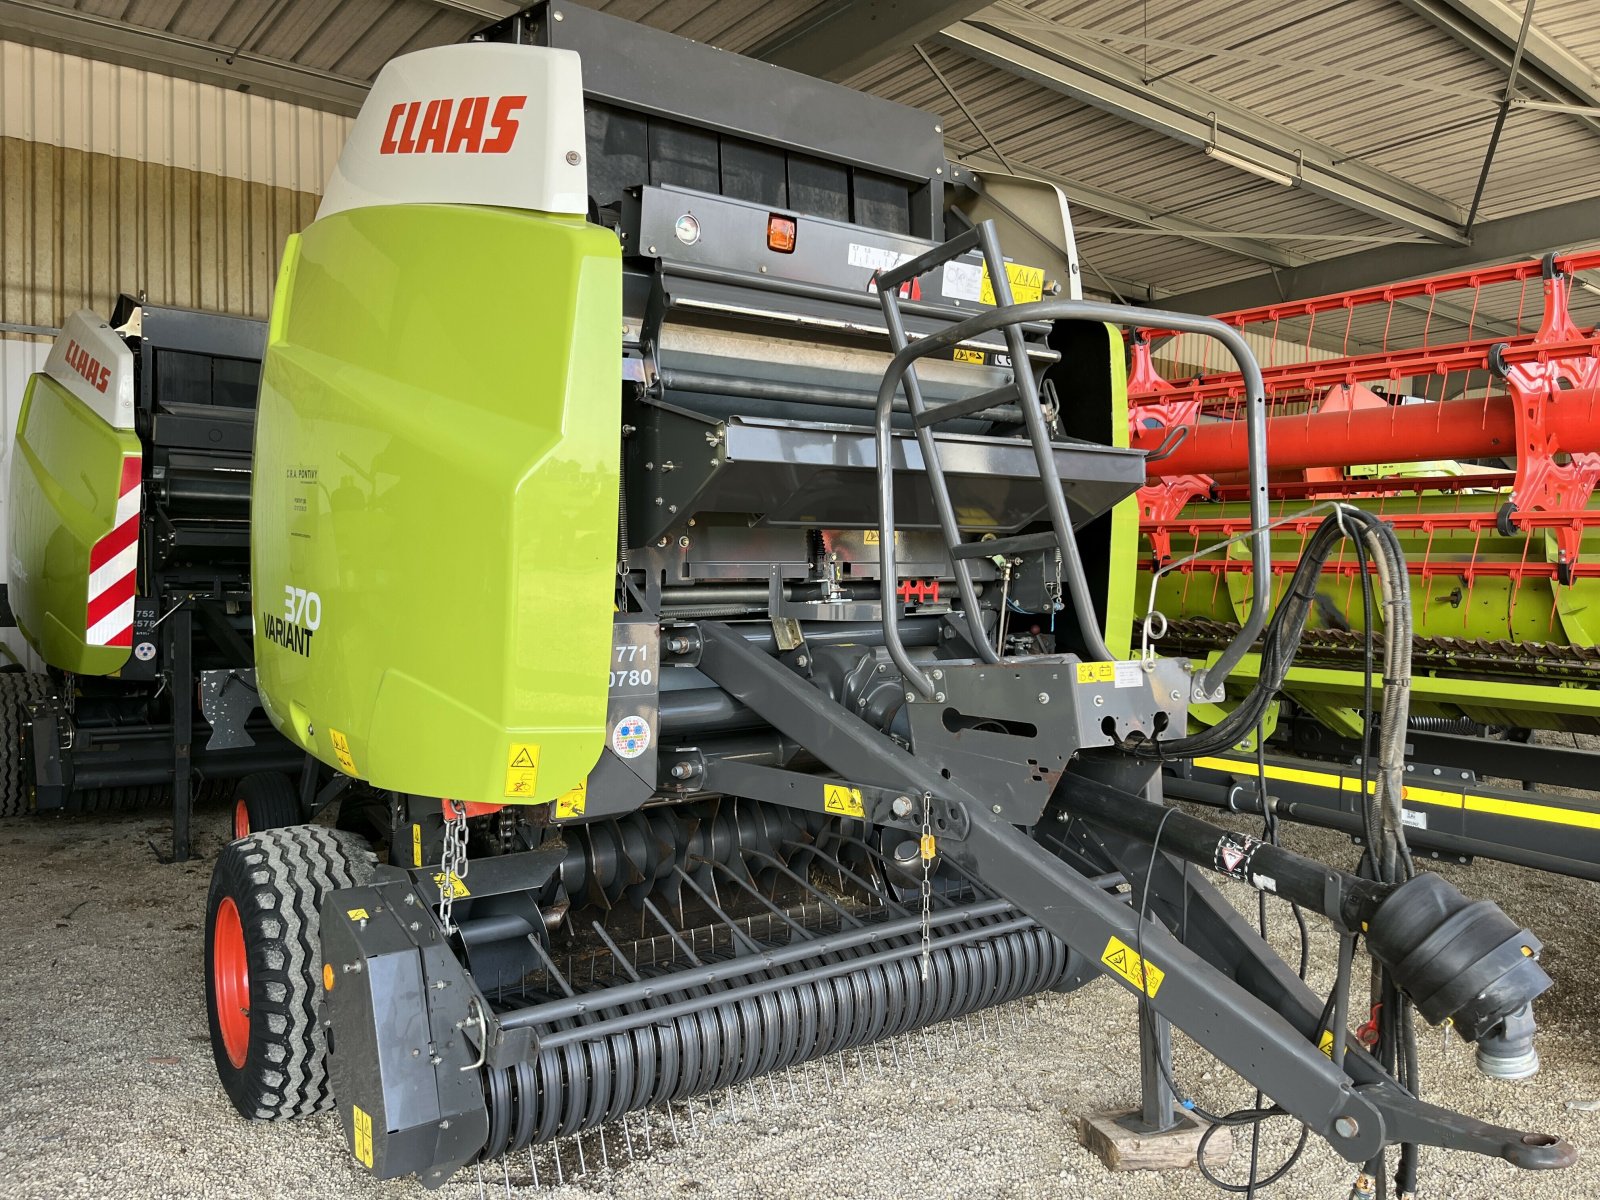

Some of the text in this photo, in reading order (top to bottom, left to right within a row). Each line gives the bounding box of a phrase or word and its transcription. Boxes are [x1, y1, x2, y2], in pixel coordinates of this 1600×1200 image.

[380, 96, 527, 154] CLAAS
[65, 339, 111, 394] CLAAS
[136, 610, 155, 618] 752
[285, 585, 321, 631] 370
[263, 612, 313, 658] VARIANT
[615, 645, 648, 662] 771
